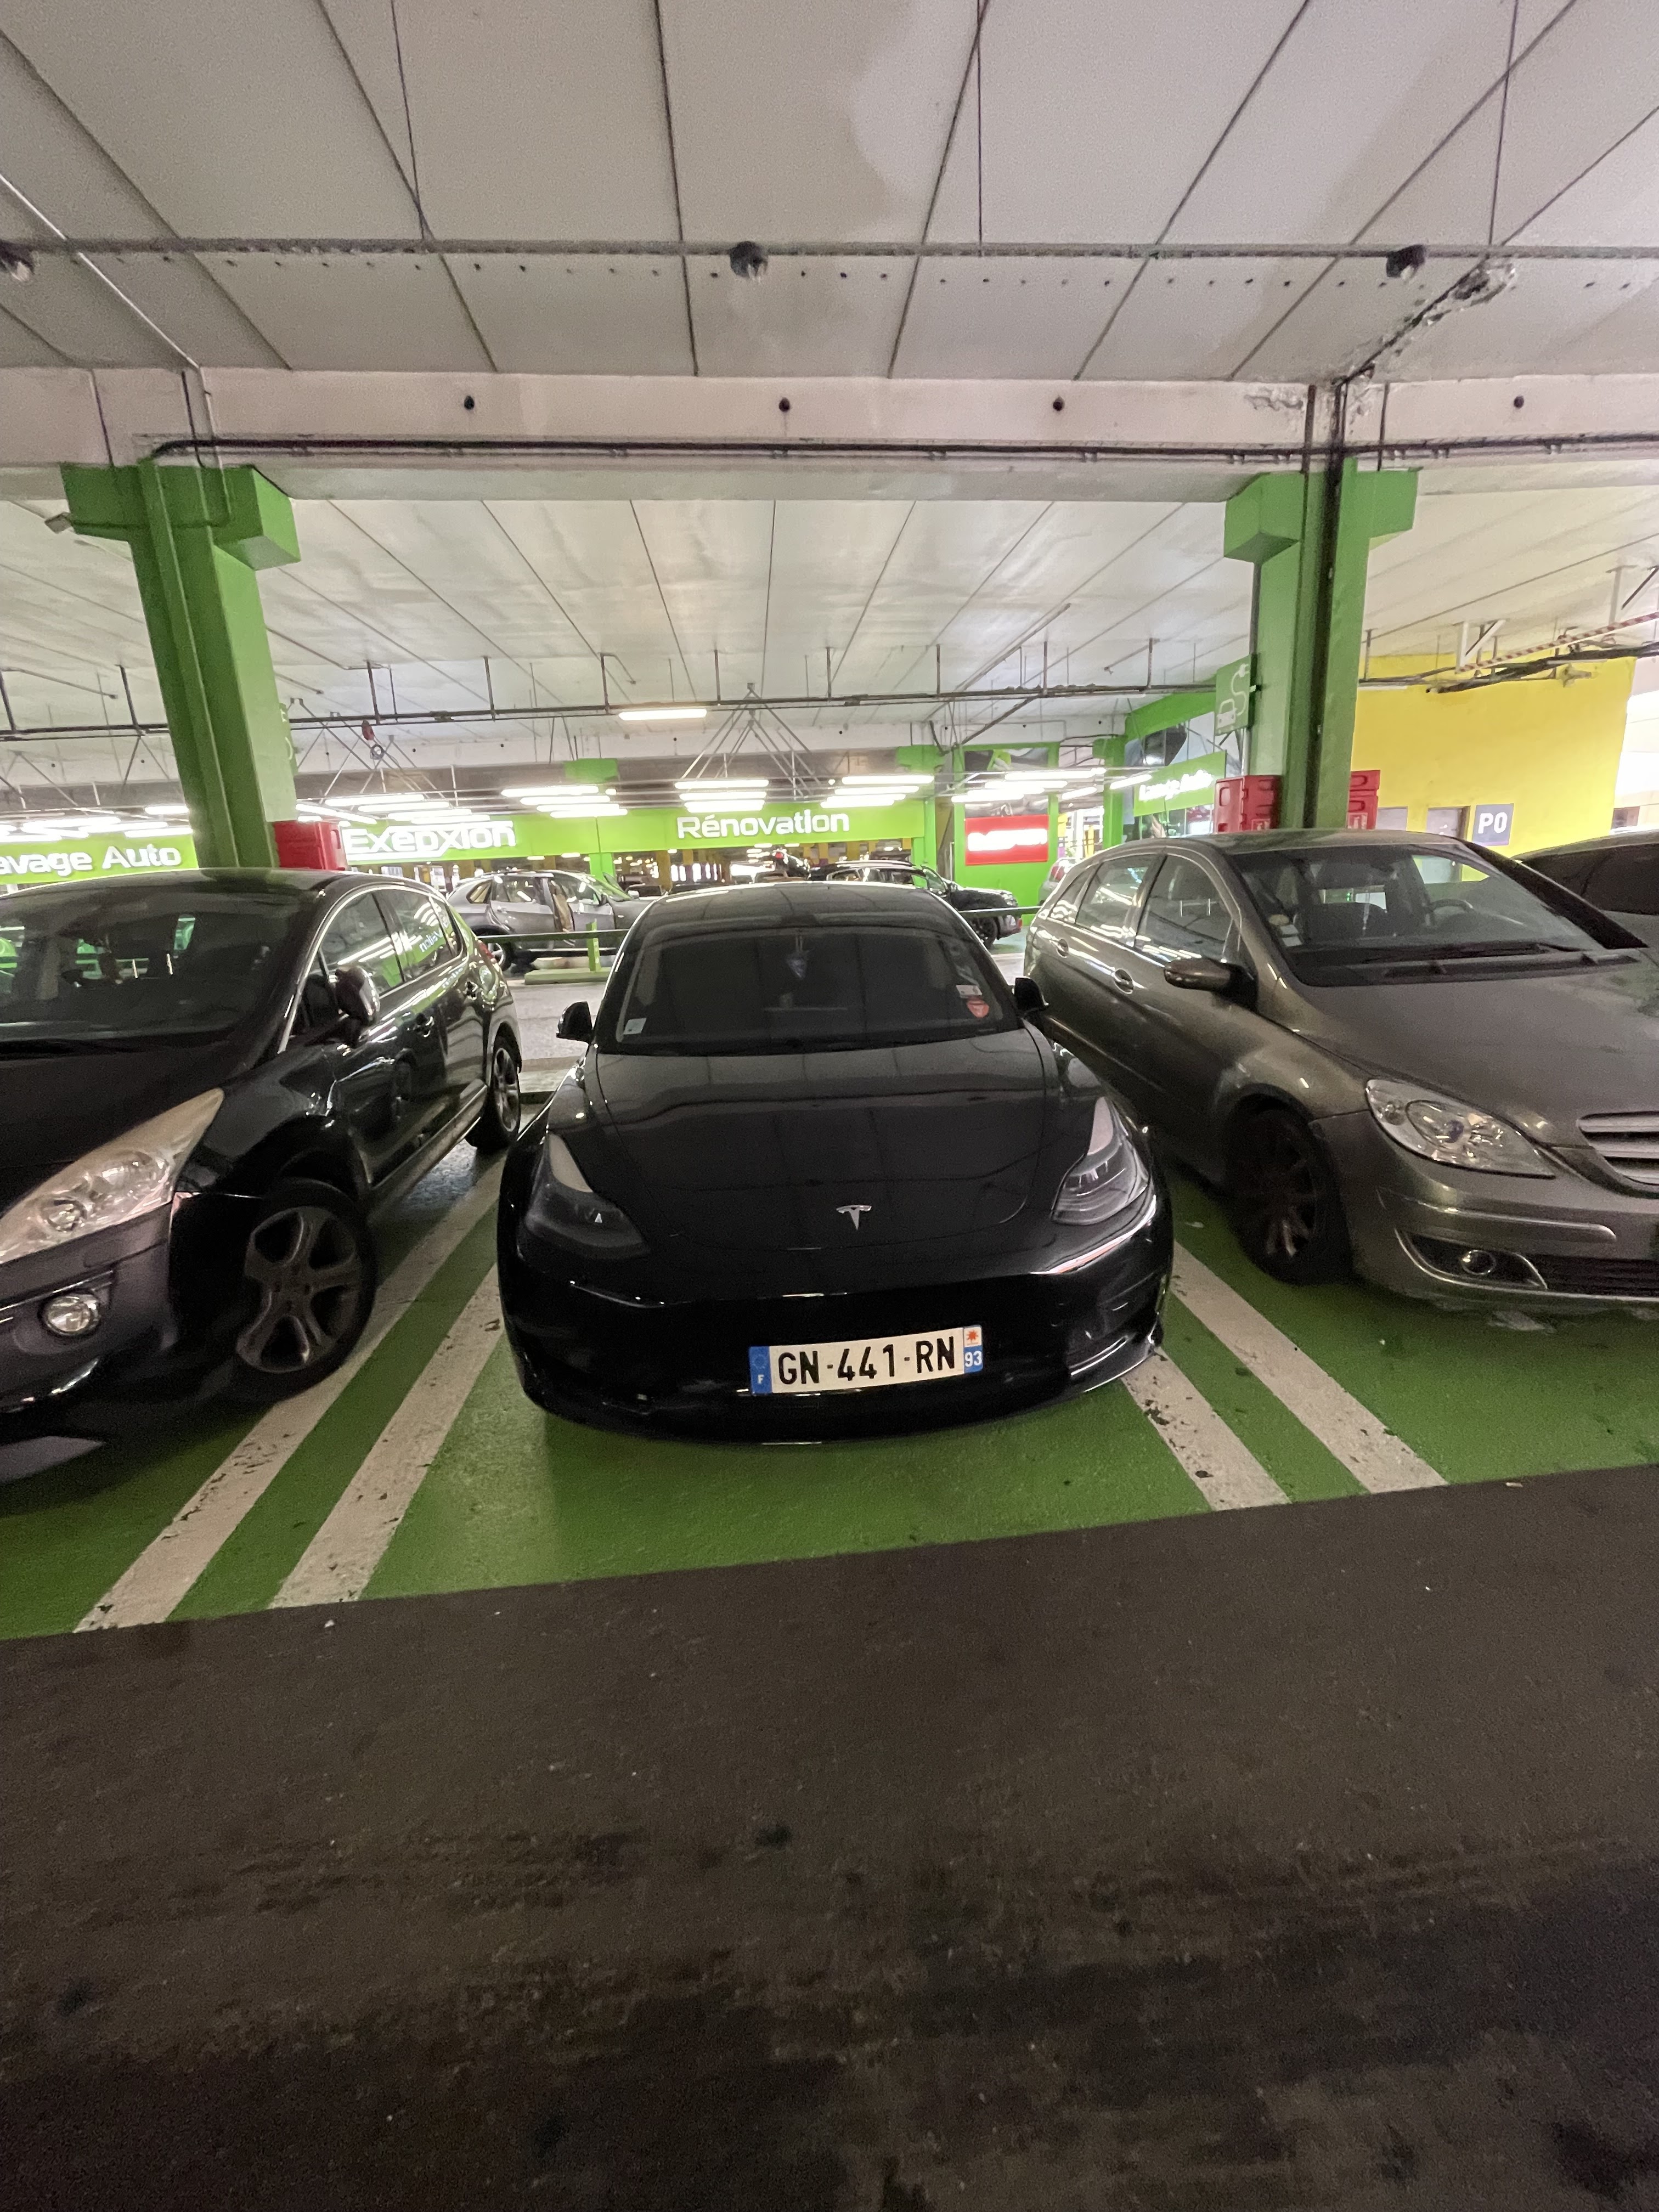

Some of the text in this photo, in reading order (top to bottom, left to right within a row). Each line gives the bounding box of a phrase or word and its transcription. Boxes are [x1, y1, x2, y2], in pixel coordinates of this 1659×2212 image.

[677, 809, 850, 839] Rénovation
[102, 844, 182, 870] Auto
[778, 1336, 955, 1384] GN-441-RN
[964, 1350, 982, 1367] 93
[758, 1374, 764, 1384] F
